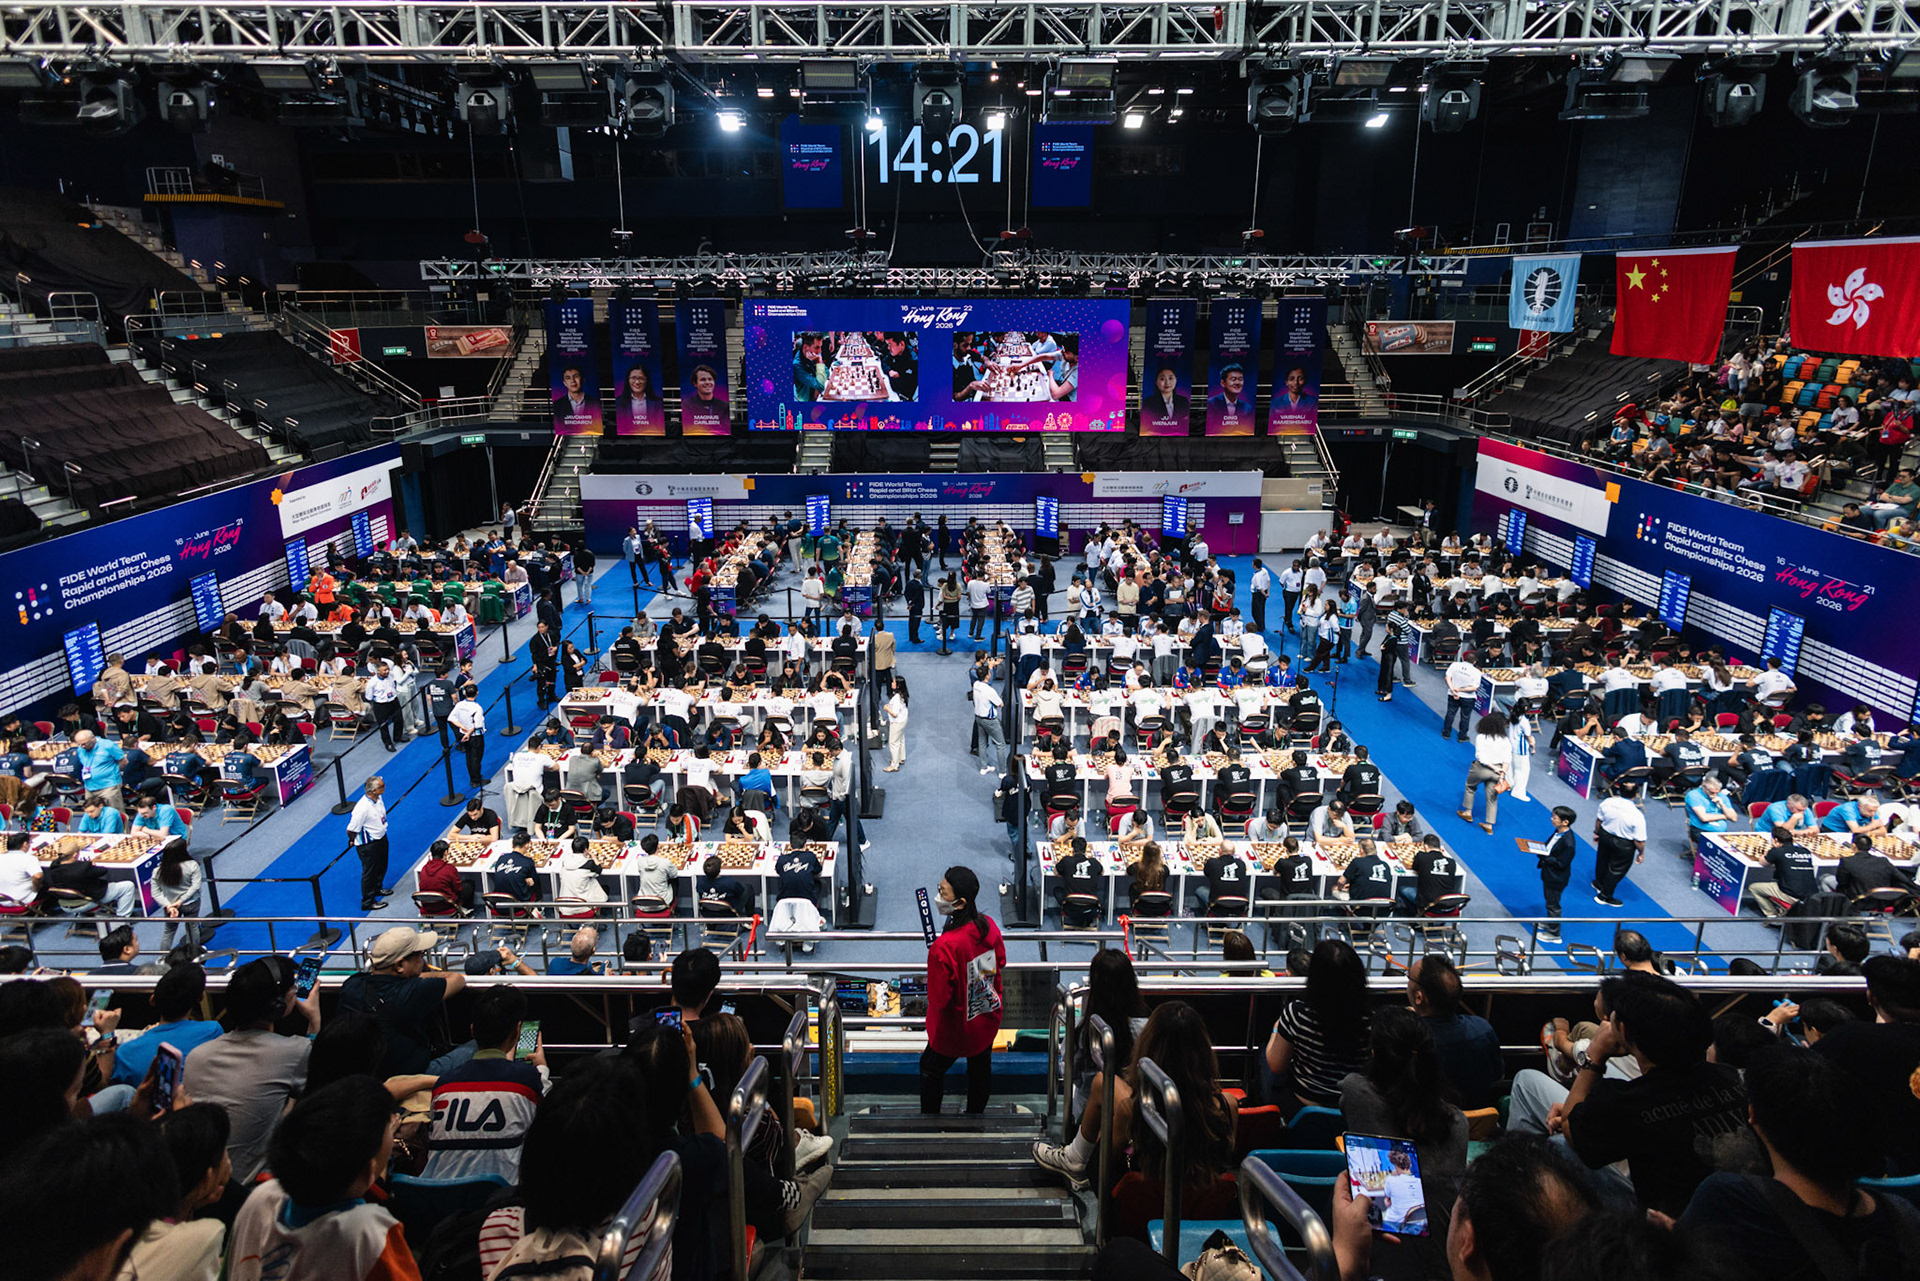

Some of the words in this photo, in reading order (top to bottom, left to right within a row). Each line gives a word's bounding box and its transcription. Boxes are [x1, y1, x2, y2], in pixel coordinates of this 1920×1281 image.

[869, 124, 1002, 183] 14:21
[902, 309, 935, 328] Hong
[936, 307, 968, 326] Kong
[944, 485, 968, 498] Hong
[969, 482, 993, 496] Kong
[179, 539, 211, 559] Hong
[213, 526, 241, 547] Kong
[194, 530, 210, 540] June
[214, 543, 231, 555] 2026
[1666, 532, 1691, 547] Rapid
[1692, 540, 1710, 553] and
[1712, 546, 1733, 561] Blitz
[1734, 554, 1766, 572] Chess
[1667, 522, 1688, 535] FIDE
[1688, 528, 1717, 544] World
[1718, 537, 1744, 553] Team
[59, 571, 86, 587] FIDE
[86, 559, 119, 577] World
[119, 552, 147, 565] Team
[62, 580, 95, 598] Rapid
[96, 573, 117, 586] and
[118, 565, 140, 578] Blitz
[141, 554, 171, 570] Chess
[1664, 542, 1735, 572] Championships
[1736, 566, 1764, 583] 2026
[1776, 556, 1786, 566] 16
[1798, 565, 1820, 577] June
[1863, 585, 1875, 595] 21
[64, 575, 146, 609] Championships
[147, 564, 173, 579] 2026
[1775, 567, 1819, 598] Hong
[1819, 578, 1869, 611] Kong
[1816, 596, 1842, 611] 2026
[921, 900, 933, 940] QUIET
[429, 1098, 506, 1132] FILA
